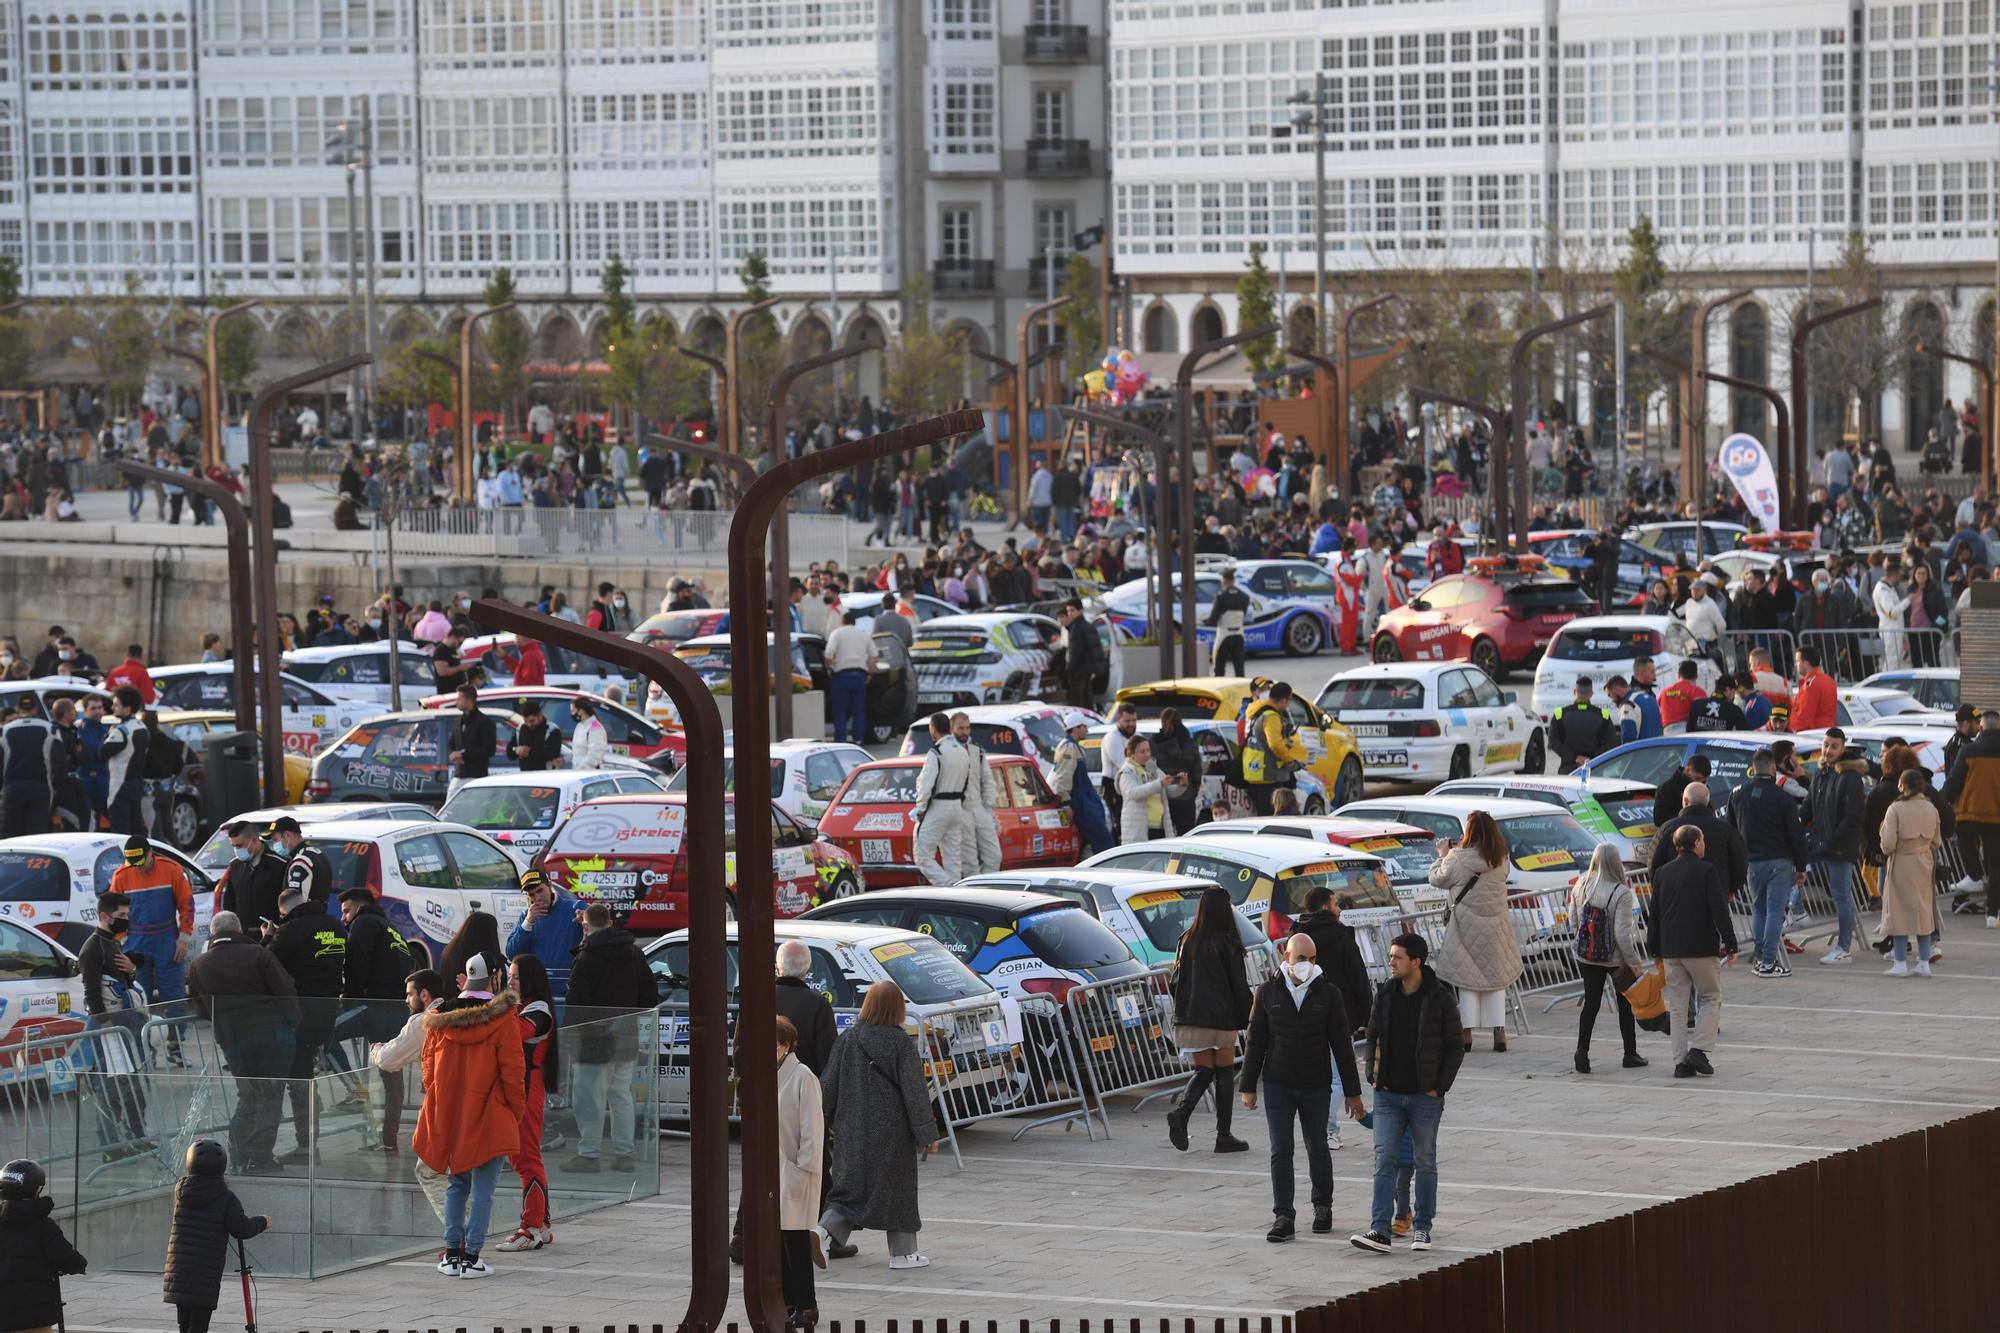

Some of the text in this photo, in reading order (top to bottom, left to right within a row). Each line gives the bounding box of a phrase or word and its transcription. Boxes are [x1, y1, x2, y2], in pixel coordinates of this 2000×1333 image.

[1197, 697, 1217, 710] 90
[991, 730, 1013, 746] 116
[346, 768, 432, 792] RENT
[529, 788, 556, 799] 97
[655, 810, 679, 822] 114
[342, 842, 370, 856] 110
[864, 851, 890, 861] 9027
[25, 857, 51, 870] 121
[639, 901, 676, 911] POSIBLE
[1239, 900, 1269, 914] OBIAN
[998, 961, 1043, 975] COBIAN
